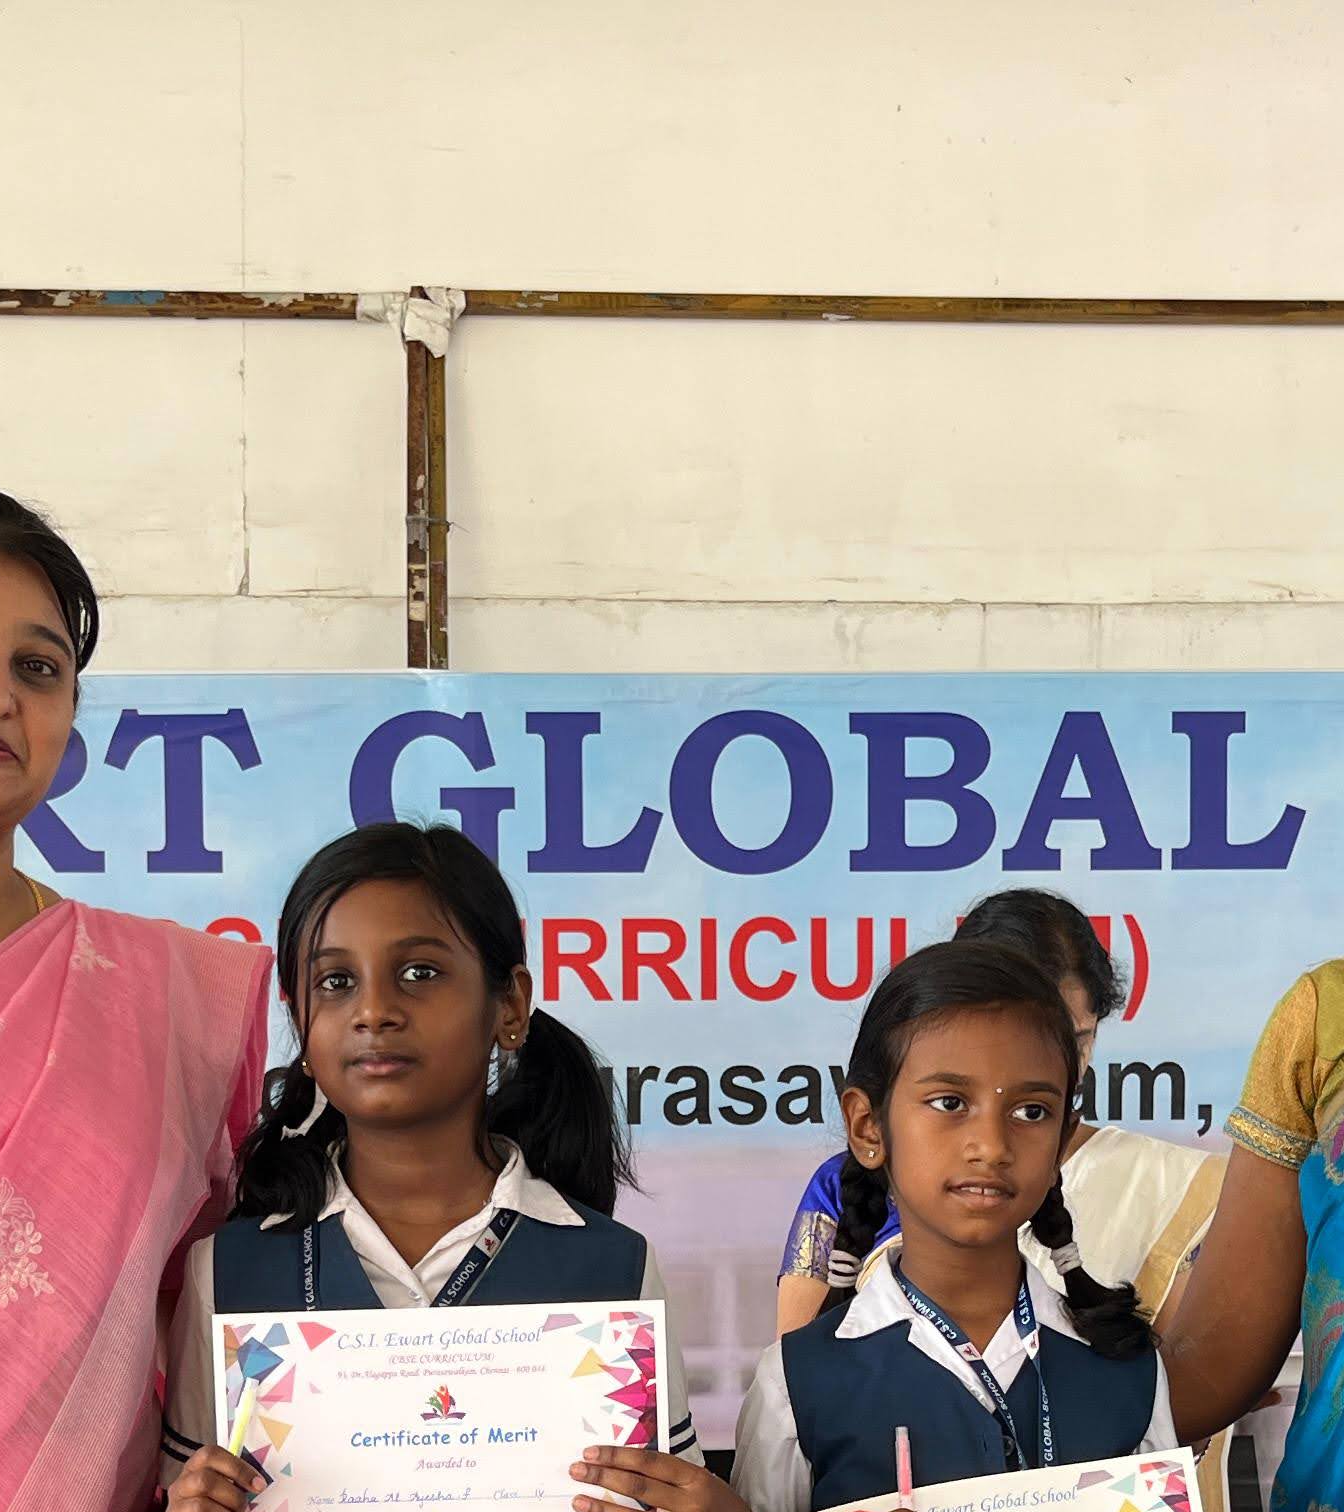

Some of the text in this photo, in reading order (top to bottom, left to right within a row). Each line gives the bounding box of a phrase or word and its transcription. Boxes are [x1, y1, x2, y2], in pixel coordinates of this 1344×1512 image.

[348, 710, 1305, 875] GLOBAL
[304, 1225, 313, 1264] SCHOOL
[305, 1264, 315, 1303] GLOBAL
[447, 1260, 479, 1298] SCHOOL
[337, 1326, 544, 1350] C.S.I. Ewart Global School
[350, 1426, 538, 1448] Certificate of Merit
[1043, 1415, 1054, 1462] GLOBAL
[415, 1457, 477, 1472] Awarded to
[1031, 1485, 1079, 1507] School
